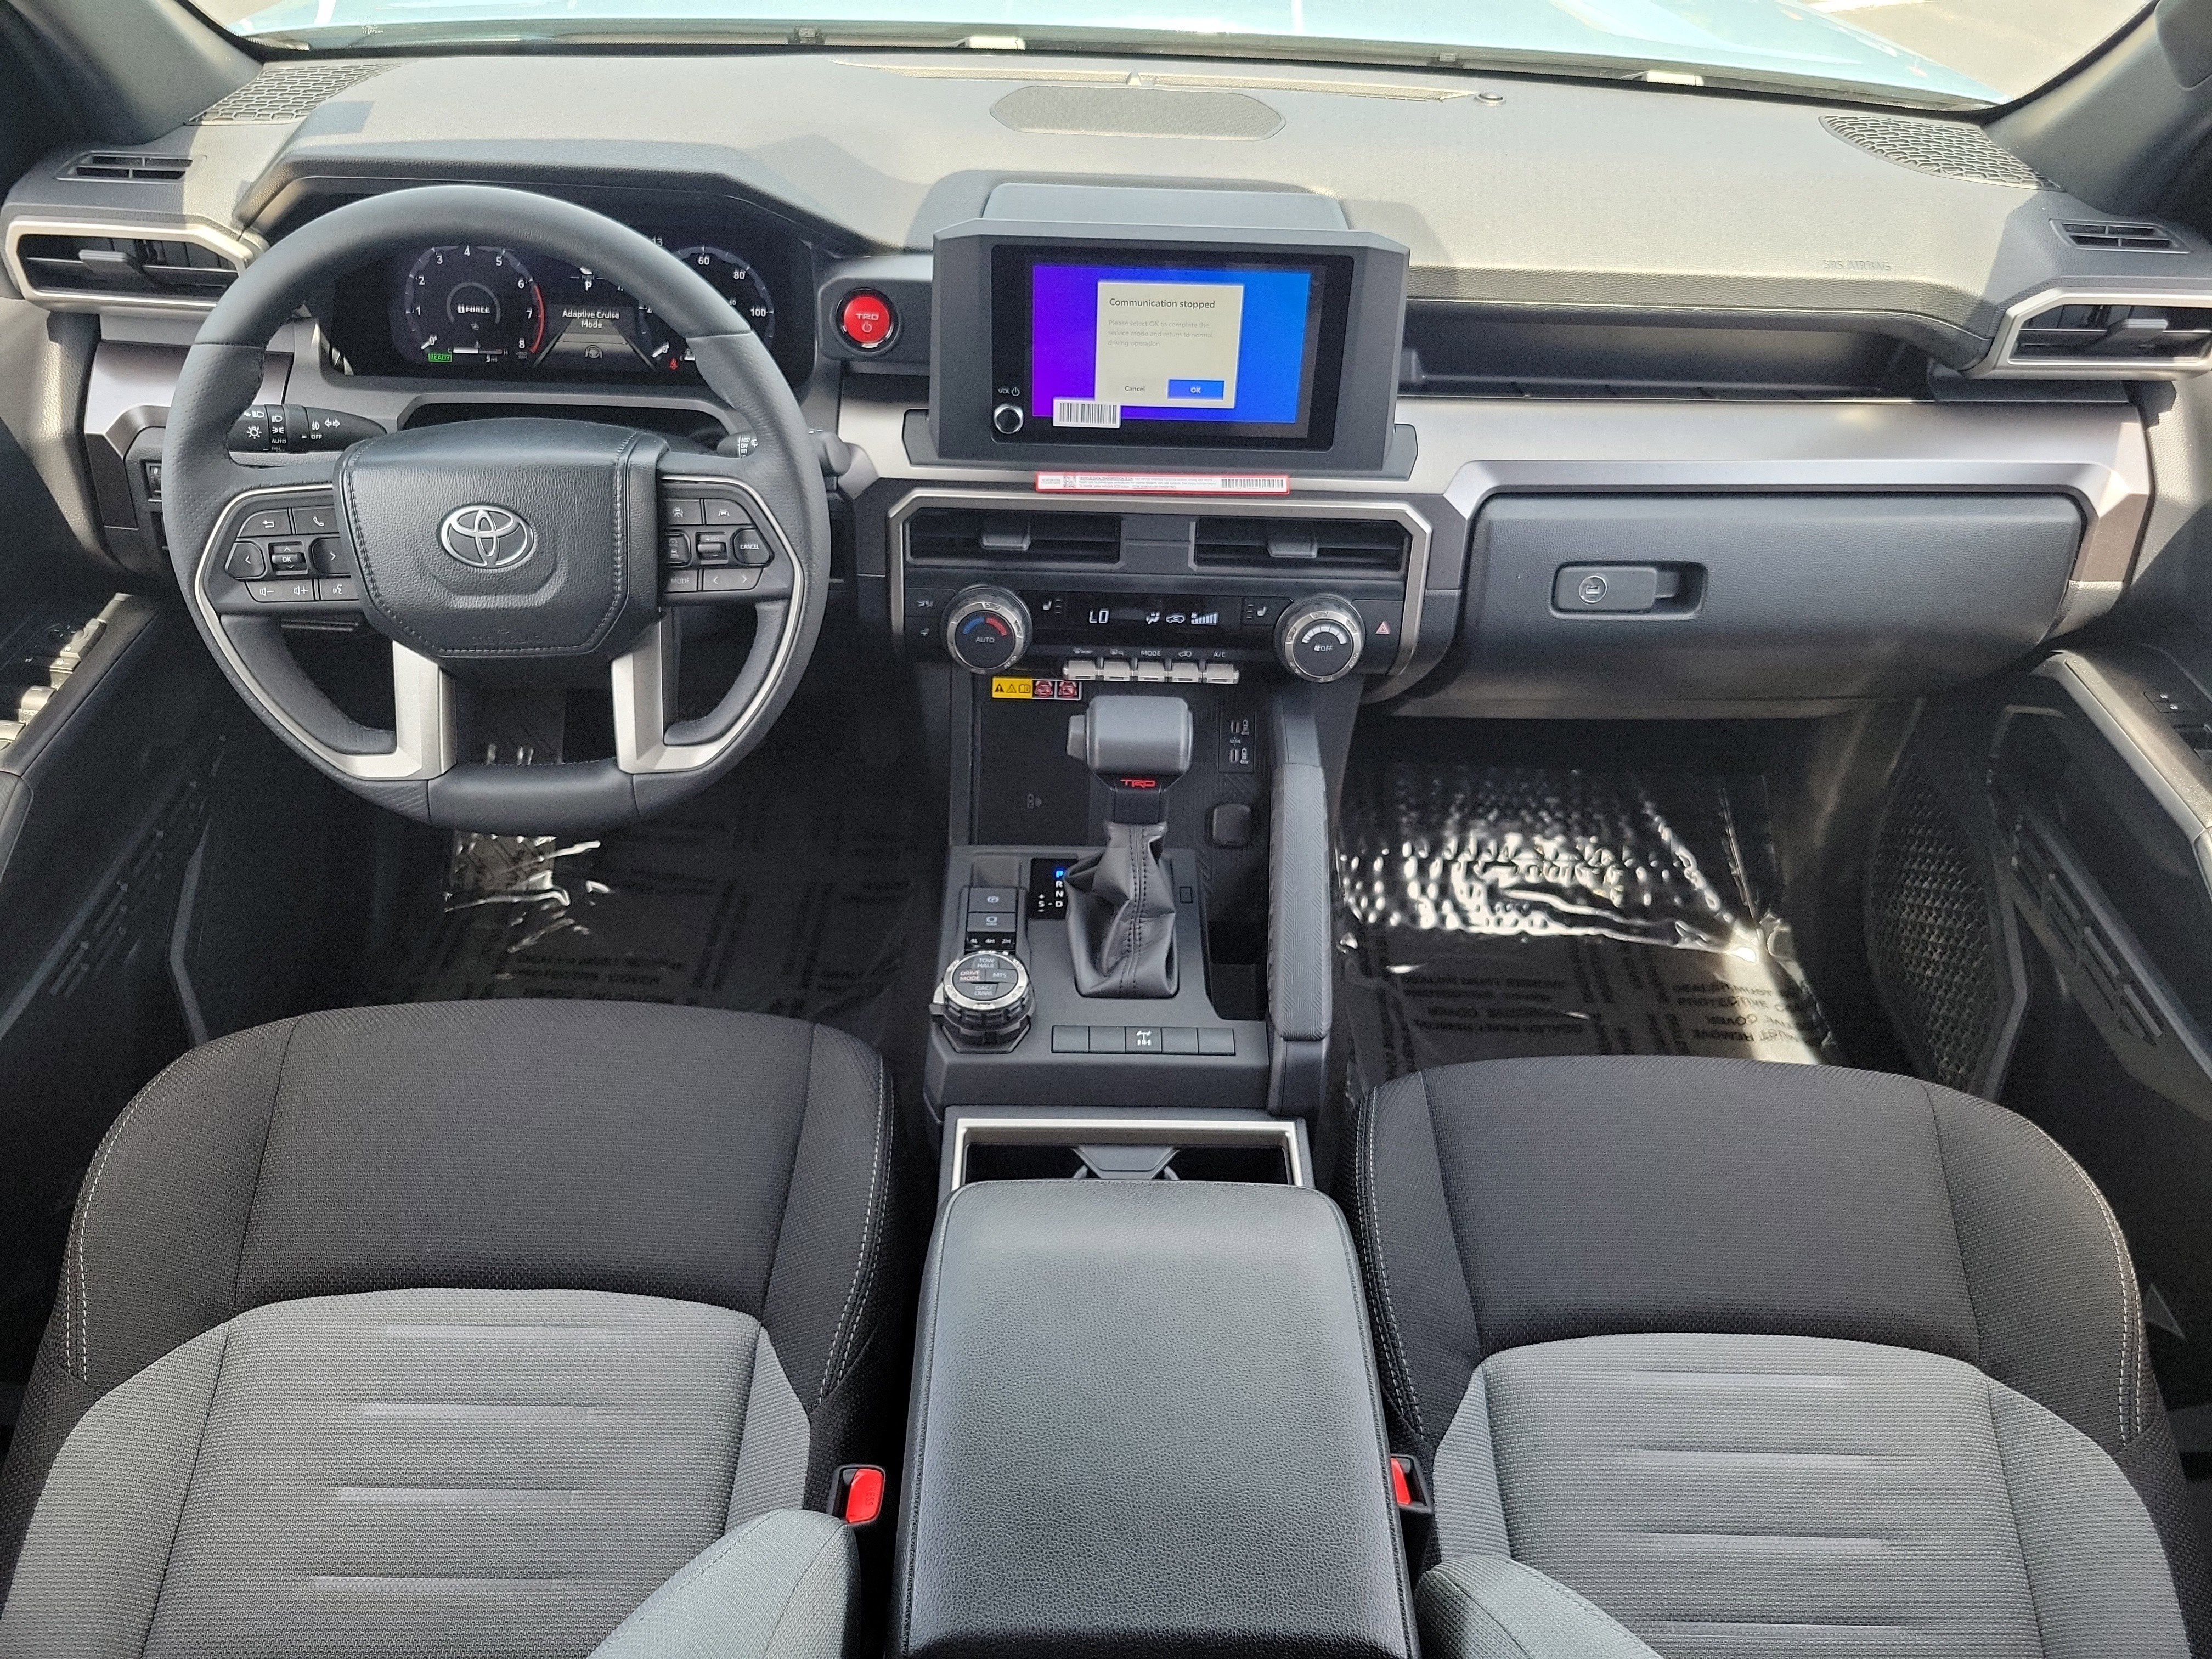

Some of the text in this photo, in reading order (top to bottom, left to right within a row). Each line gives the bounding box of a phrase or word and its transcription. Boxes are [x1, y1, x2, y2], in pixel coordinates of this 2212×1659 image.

[464, 246, 471, 257] 4
[437, 255, 443, 264] 3
[496, 256, 503, 266] 5
[1823, 259, 1891, 271] SRS AIRBAG
[418, 275, 425, 285] 2
[733, 270, 745, 280] 80
[518, 279, 524, 289] 6
[585, 281, 592, 291] P
[1109, 298, 1215, 309] Communication stopped
[416, 306, 421, 315] 1
[526, 308, 533, 319] 7
[562, 309, 620, 319] Adaptive Cruise
[751, 308, 766, 317] 100
[582, 320, 602, 328] Mode
[519, 338, 525, 348] 8
[1088, 610, 1109, 624] LO
[1120, 779, 1155, 788] TRD
[1056, 870, 1064, 878] P
[1055, 880, 1063, 888] R
